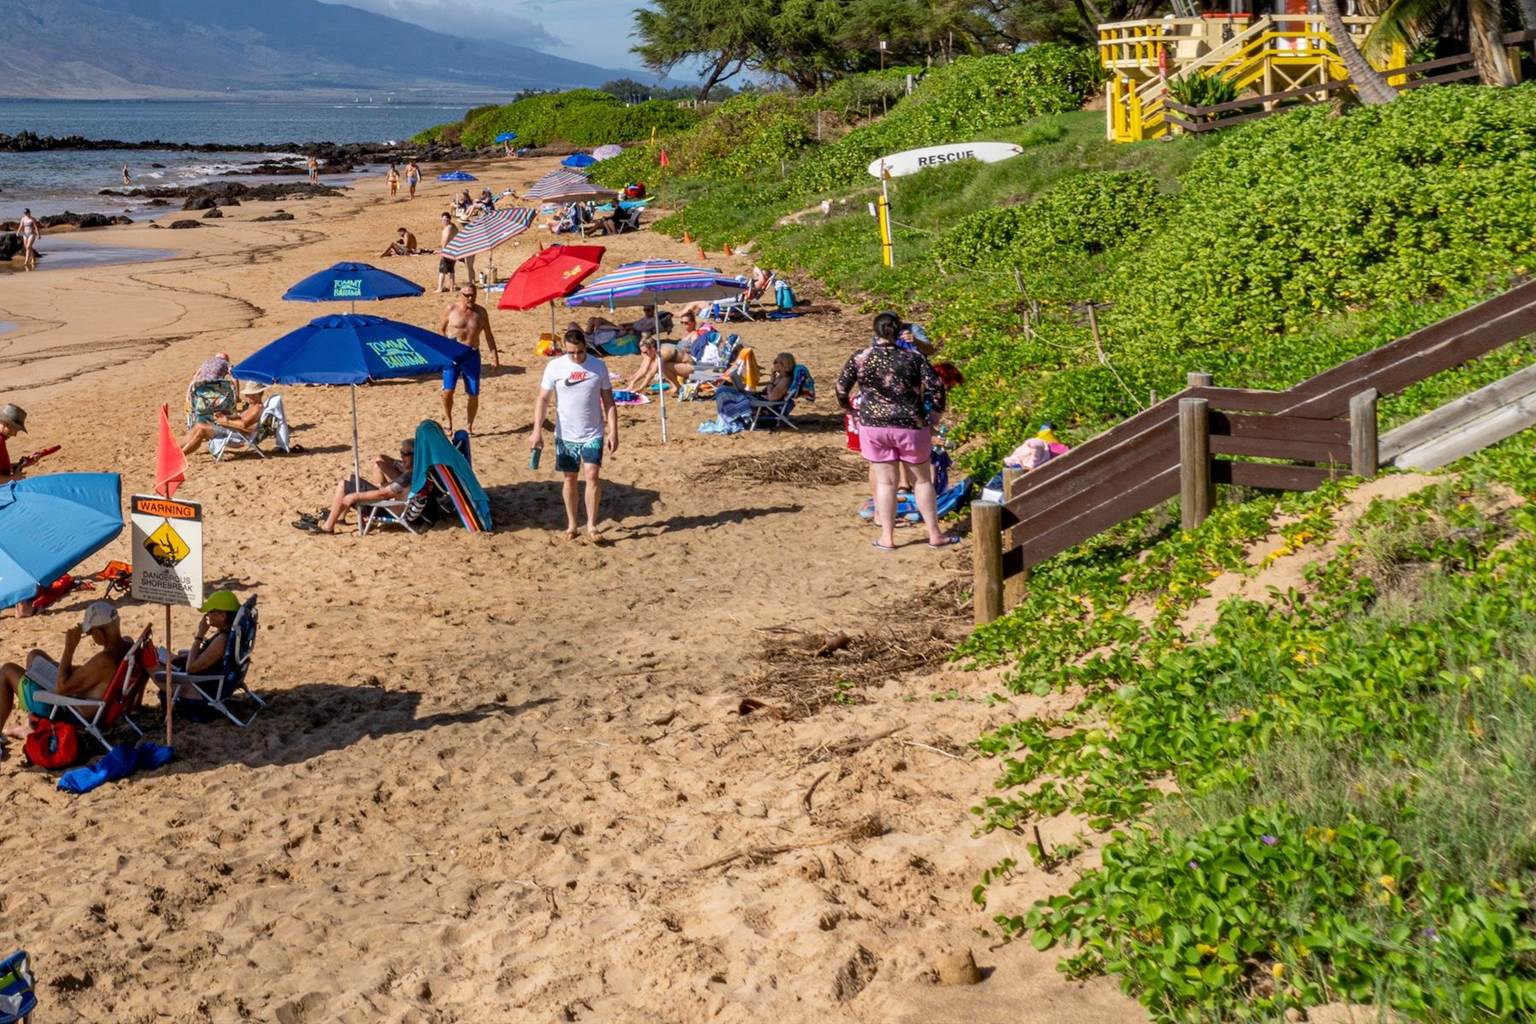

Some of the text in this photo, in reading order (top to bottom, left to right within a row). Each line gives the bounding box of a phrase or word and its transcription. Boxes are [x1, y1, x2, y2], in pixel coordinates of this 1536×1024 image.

[918, 150, 974, 166] RESCUE
[334, 279, 362, 288] TOMMY
[366, 337, 415, 356] TOMMY
[381, 351, 428, 369] BAHAMA
[569, 371, 588, 381] NIKE
[140, 502, 192, 517] WARNING
[141, 578, 193, 592] SHOREBREAK
[143, 571, 191, 585] DANGEROUS
